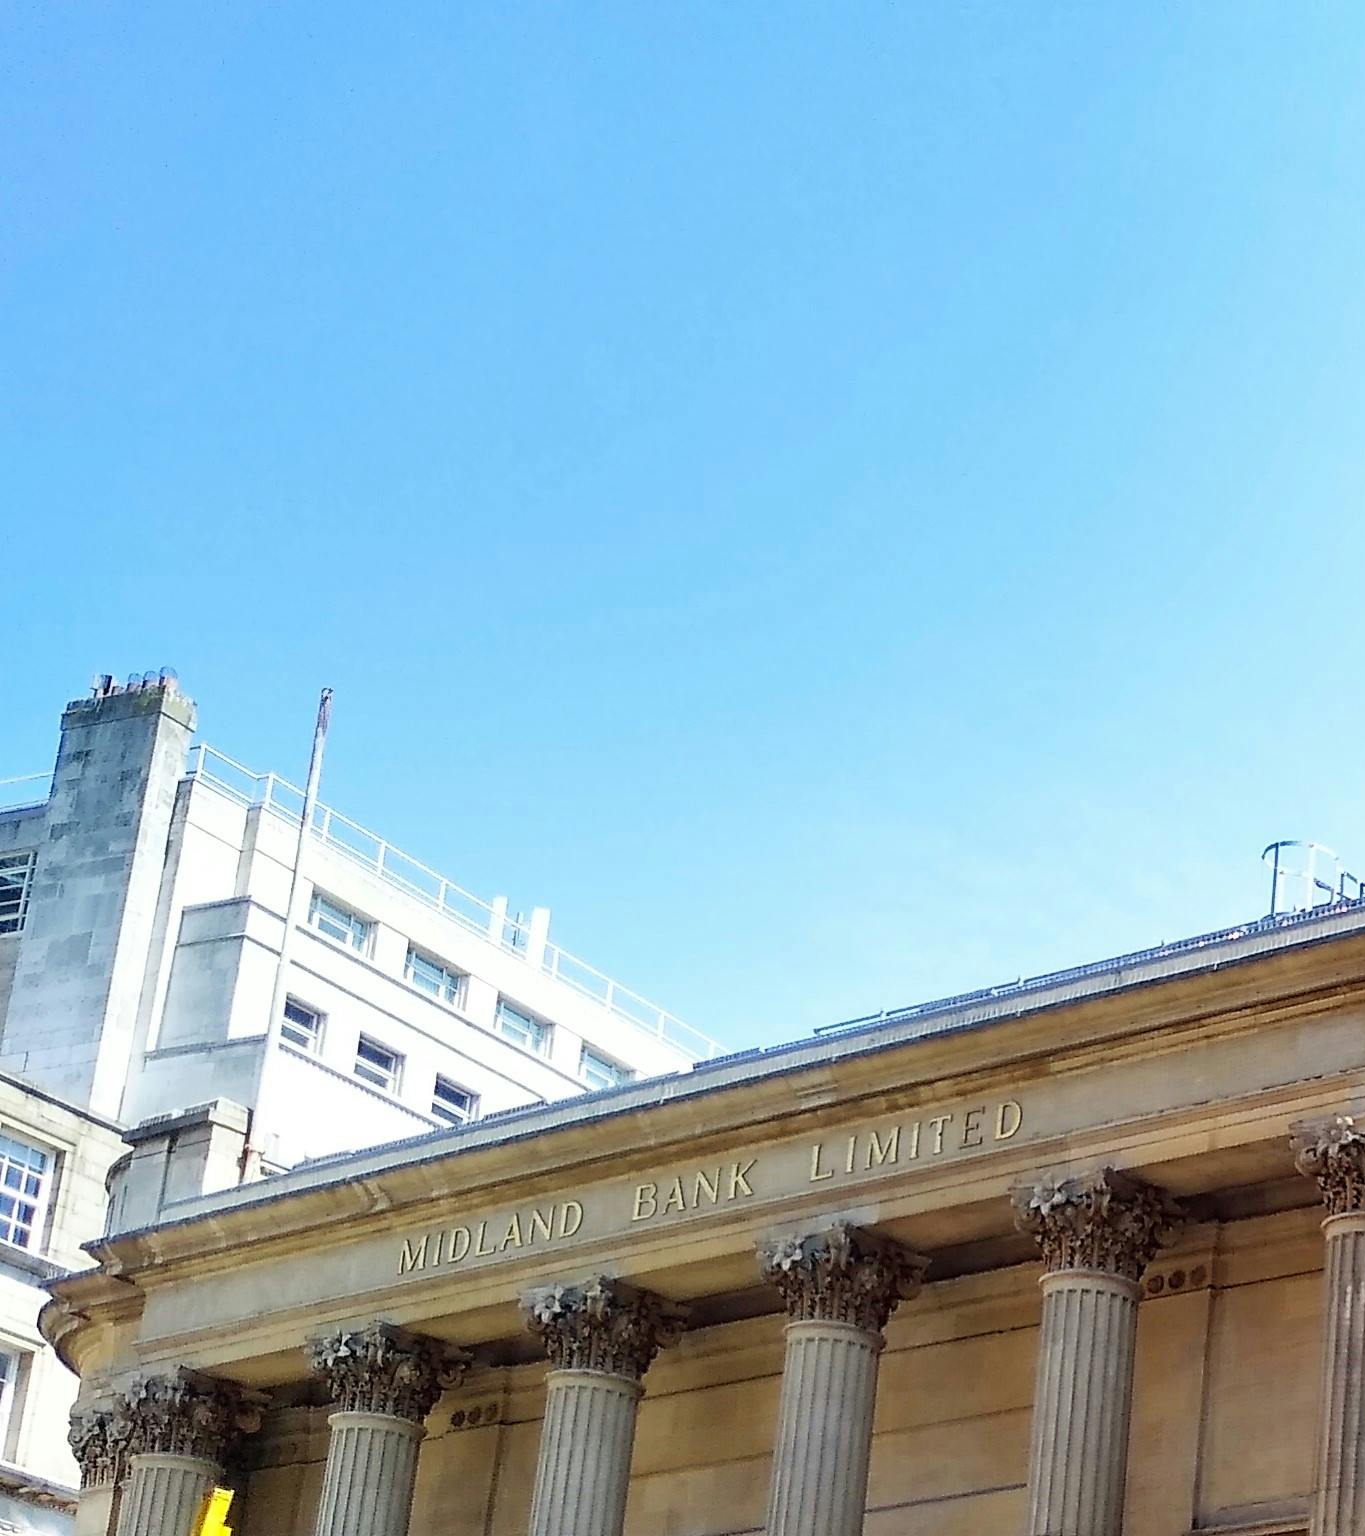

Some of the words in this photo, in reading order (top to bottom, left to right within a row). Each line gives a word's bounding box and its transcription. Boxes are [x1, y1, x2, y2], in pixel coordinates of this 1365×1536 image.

[396, 1200, 586, 1277] MIDLAND
[631, 1158, 760, 1222] BANK
[808, 1099, 1026, 1183] LIMITED
